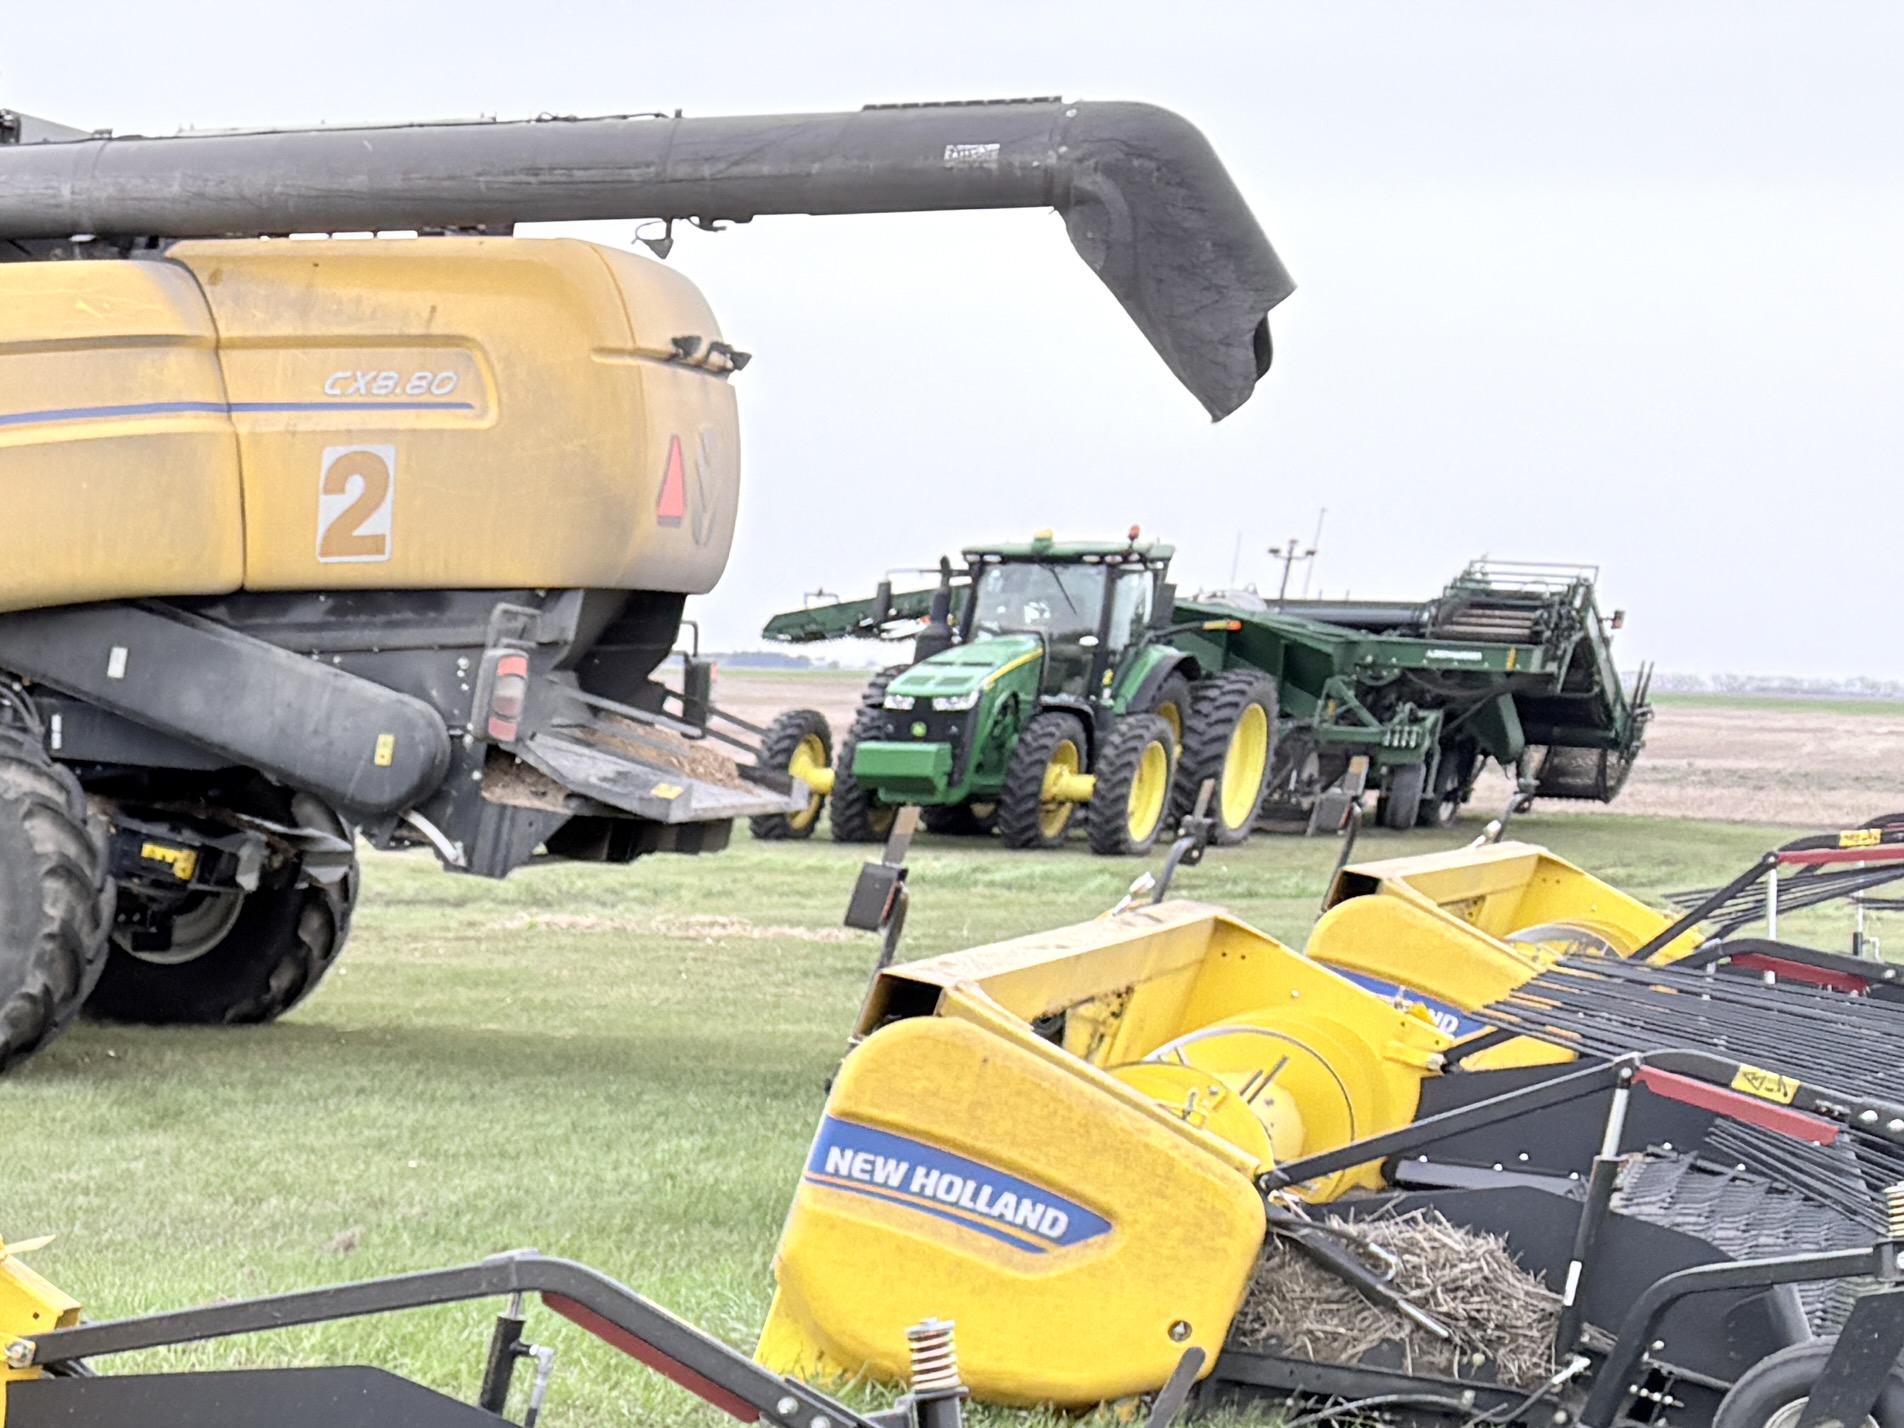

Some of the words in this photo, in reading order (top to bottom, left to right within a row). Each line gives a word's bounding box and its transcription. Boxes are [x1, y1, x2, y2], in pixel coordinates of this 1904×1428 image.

[324, 371, 458, 396] CX8.80
[319, 450, 390, 558] 2
[825, 1146, 909, 1188] NEW
[909, 1165, 1069, 1239] HOLLAND
